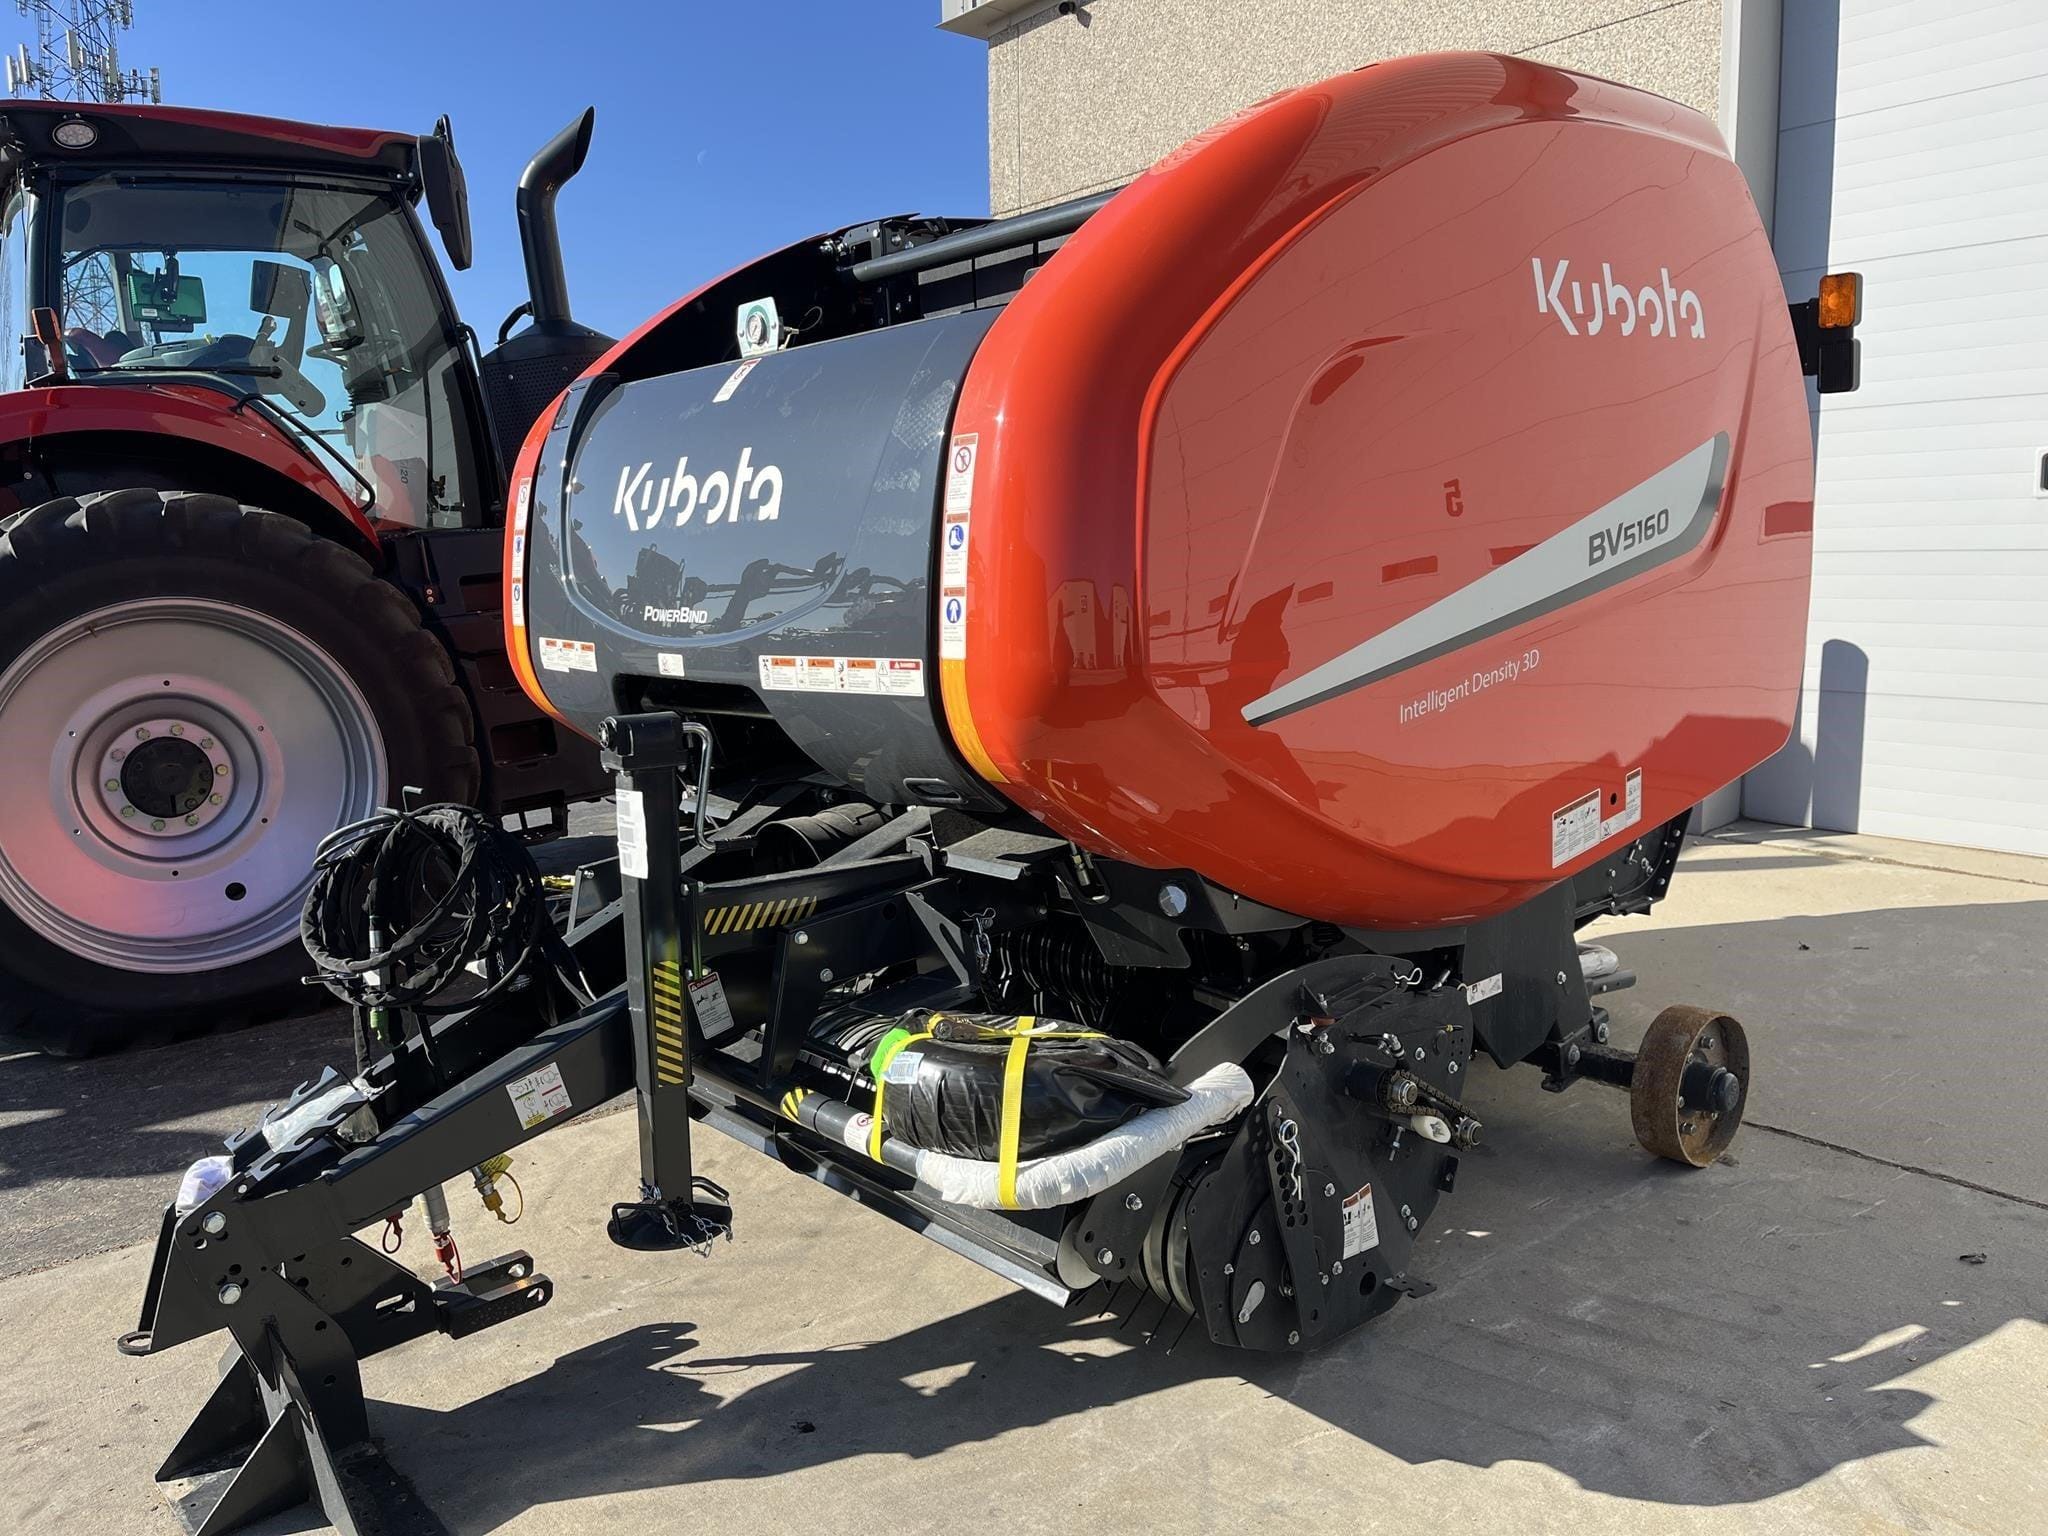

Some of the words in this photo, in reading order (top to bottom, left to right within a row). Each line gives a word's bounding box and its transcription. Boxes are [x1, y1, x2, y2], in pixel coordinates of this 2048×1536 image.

[1532, 258, 1705, 338] Kubota
[613, 447, 783, 531] Kubota
[1588, 508, 1669, 567] BV5160
[1400, 679, 1470, 724] Intelligent
[1472, 660, 1520, 693] Density
[1522, 649, 1540, 672] 3D
